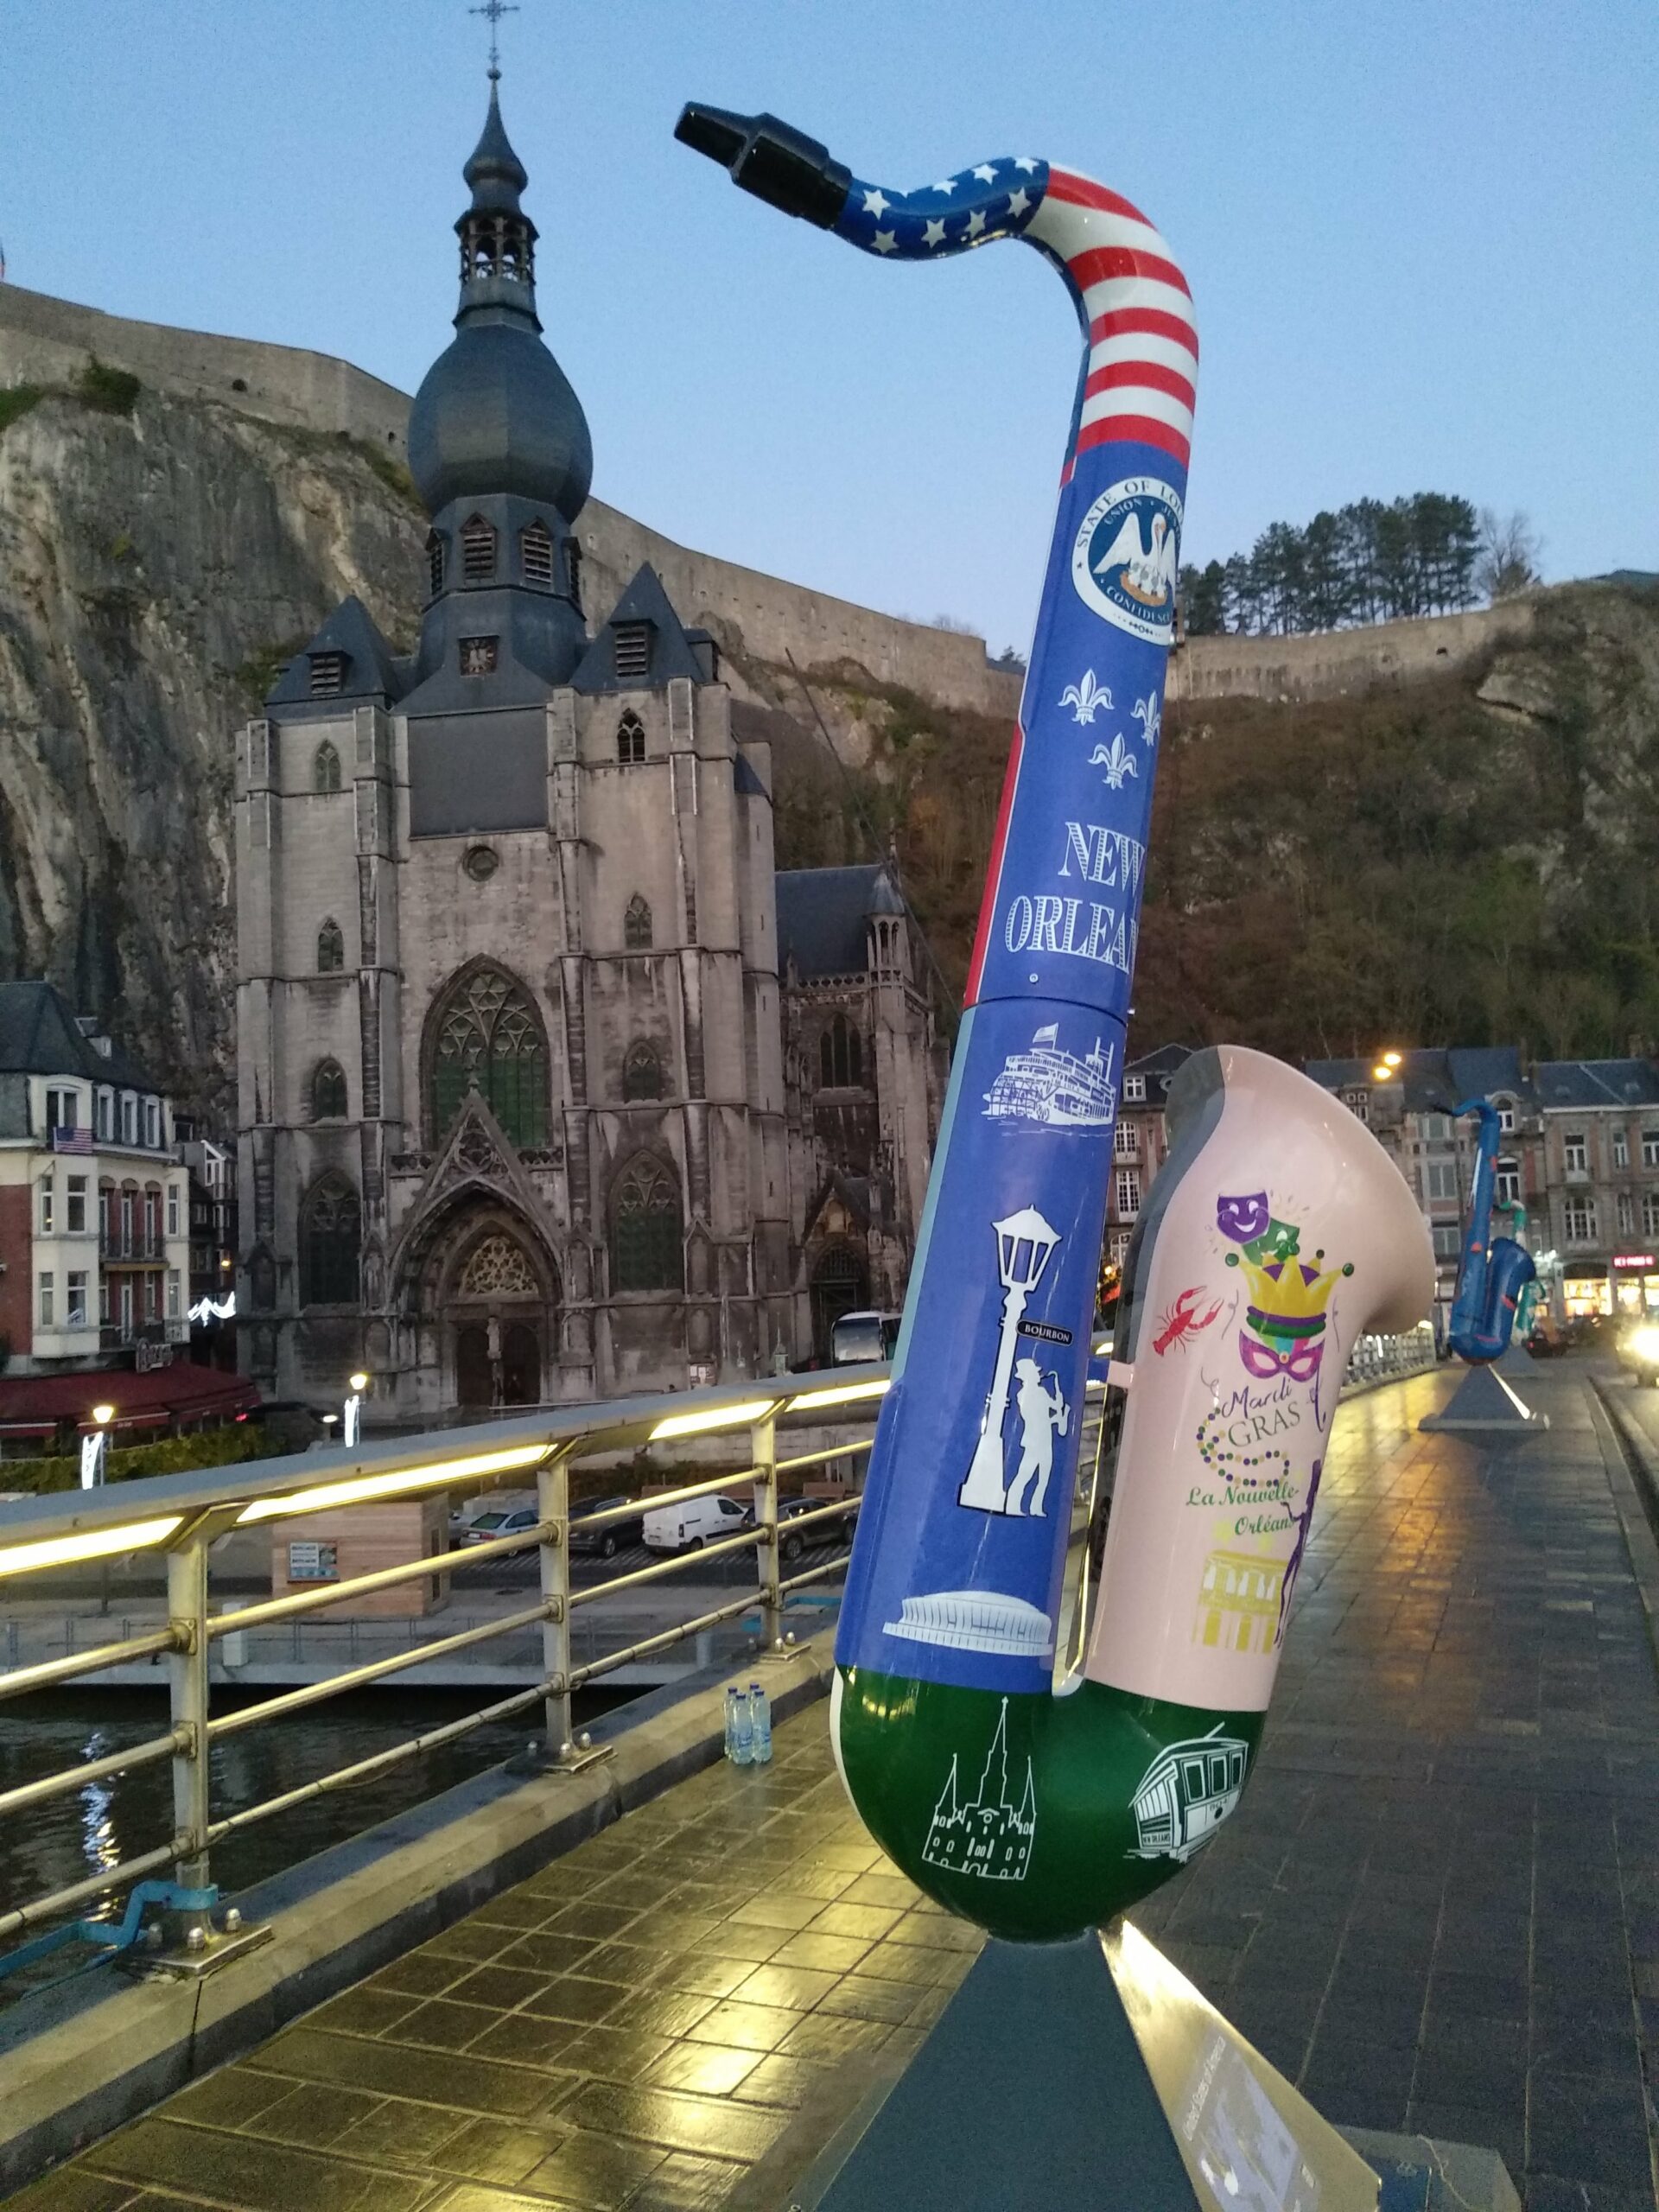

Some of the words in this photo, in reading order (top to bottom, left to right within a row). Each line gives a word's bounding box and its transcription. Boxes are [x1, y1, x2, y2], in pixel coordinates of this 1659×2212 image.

[1077, 492, 1116, 548] STATE
[1124, 480, 1150, 494] OF
[1104, 498, 1142, 525] UNION
[1058, 822, 1146, 899] NEW
[1025, 1324, 1070, 1343] BOURBON
[1222, 1376, 1293, 1419] Mardi
[1228, 1402, 1300, 1447] GRAS
[1185, 1486, 1215, 1506] La
[1235, 1514, 1296, 1535] Orléans
